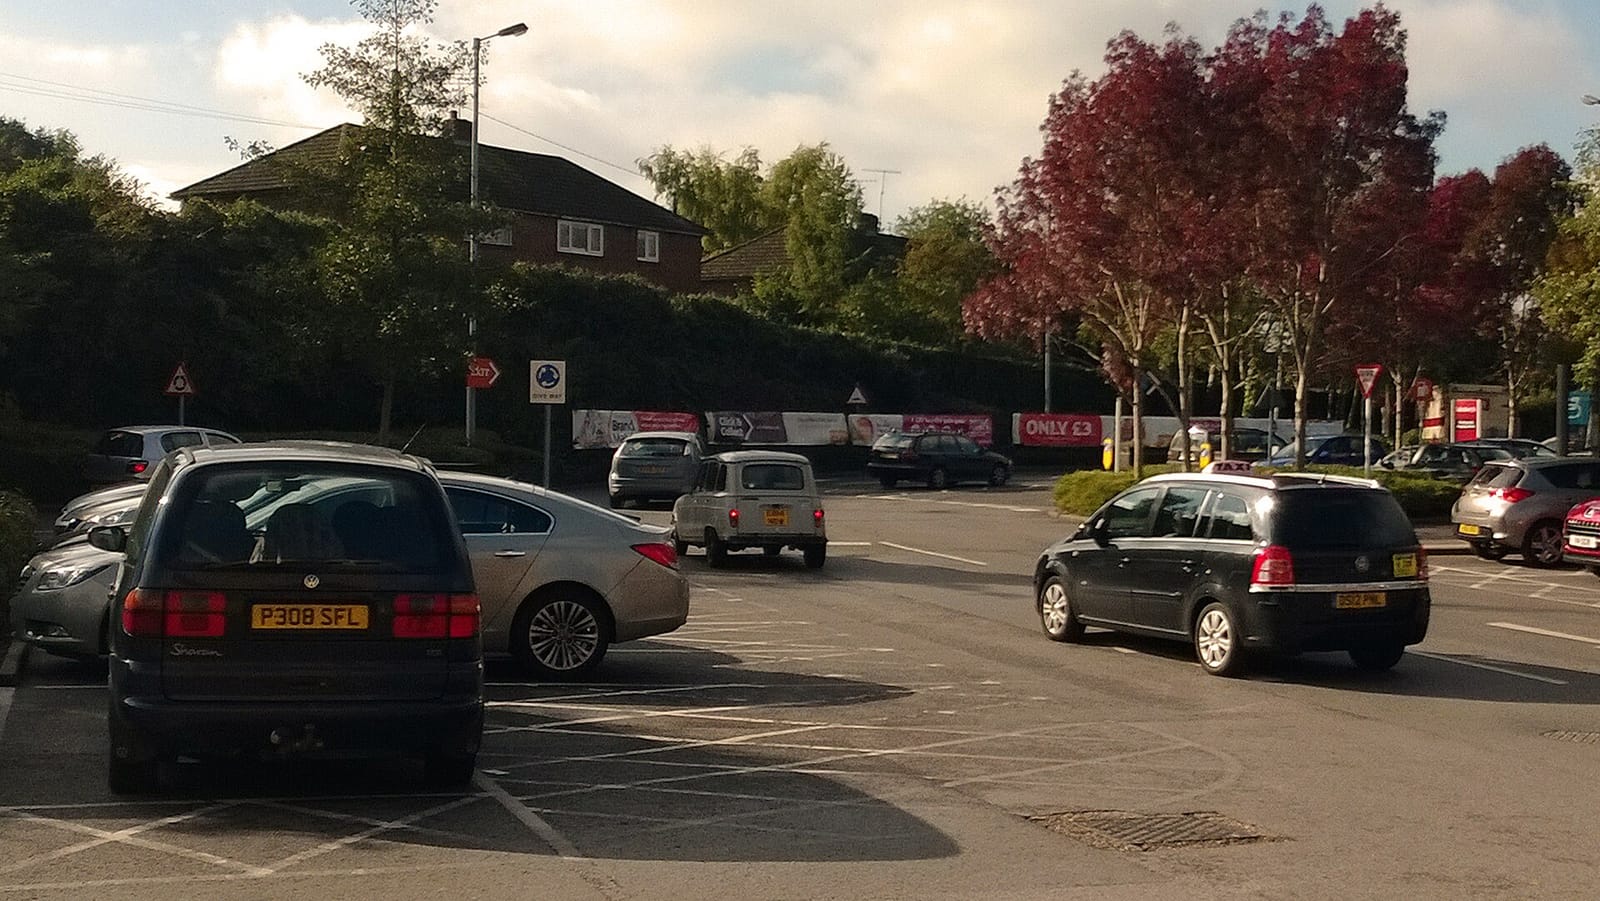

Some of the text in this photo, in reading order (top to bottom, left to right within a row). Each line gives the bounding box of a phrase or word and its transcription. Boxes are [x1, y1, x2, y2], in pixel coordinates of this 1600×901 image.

[612, 420, 635, 432] Brand
[1026, 420, 1092, 436] ONLY £3
[1214, 462, 1250, 471] TAXI
[260, 608, 360, 626] P308 SFL
[170, 643, 224, 657] Sharan
